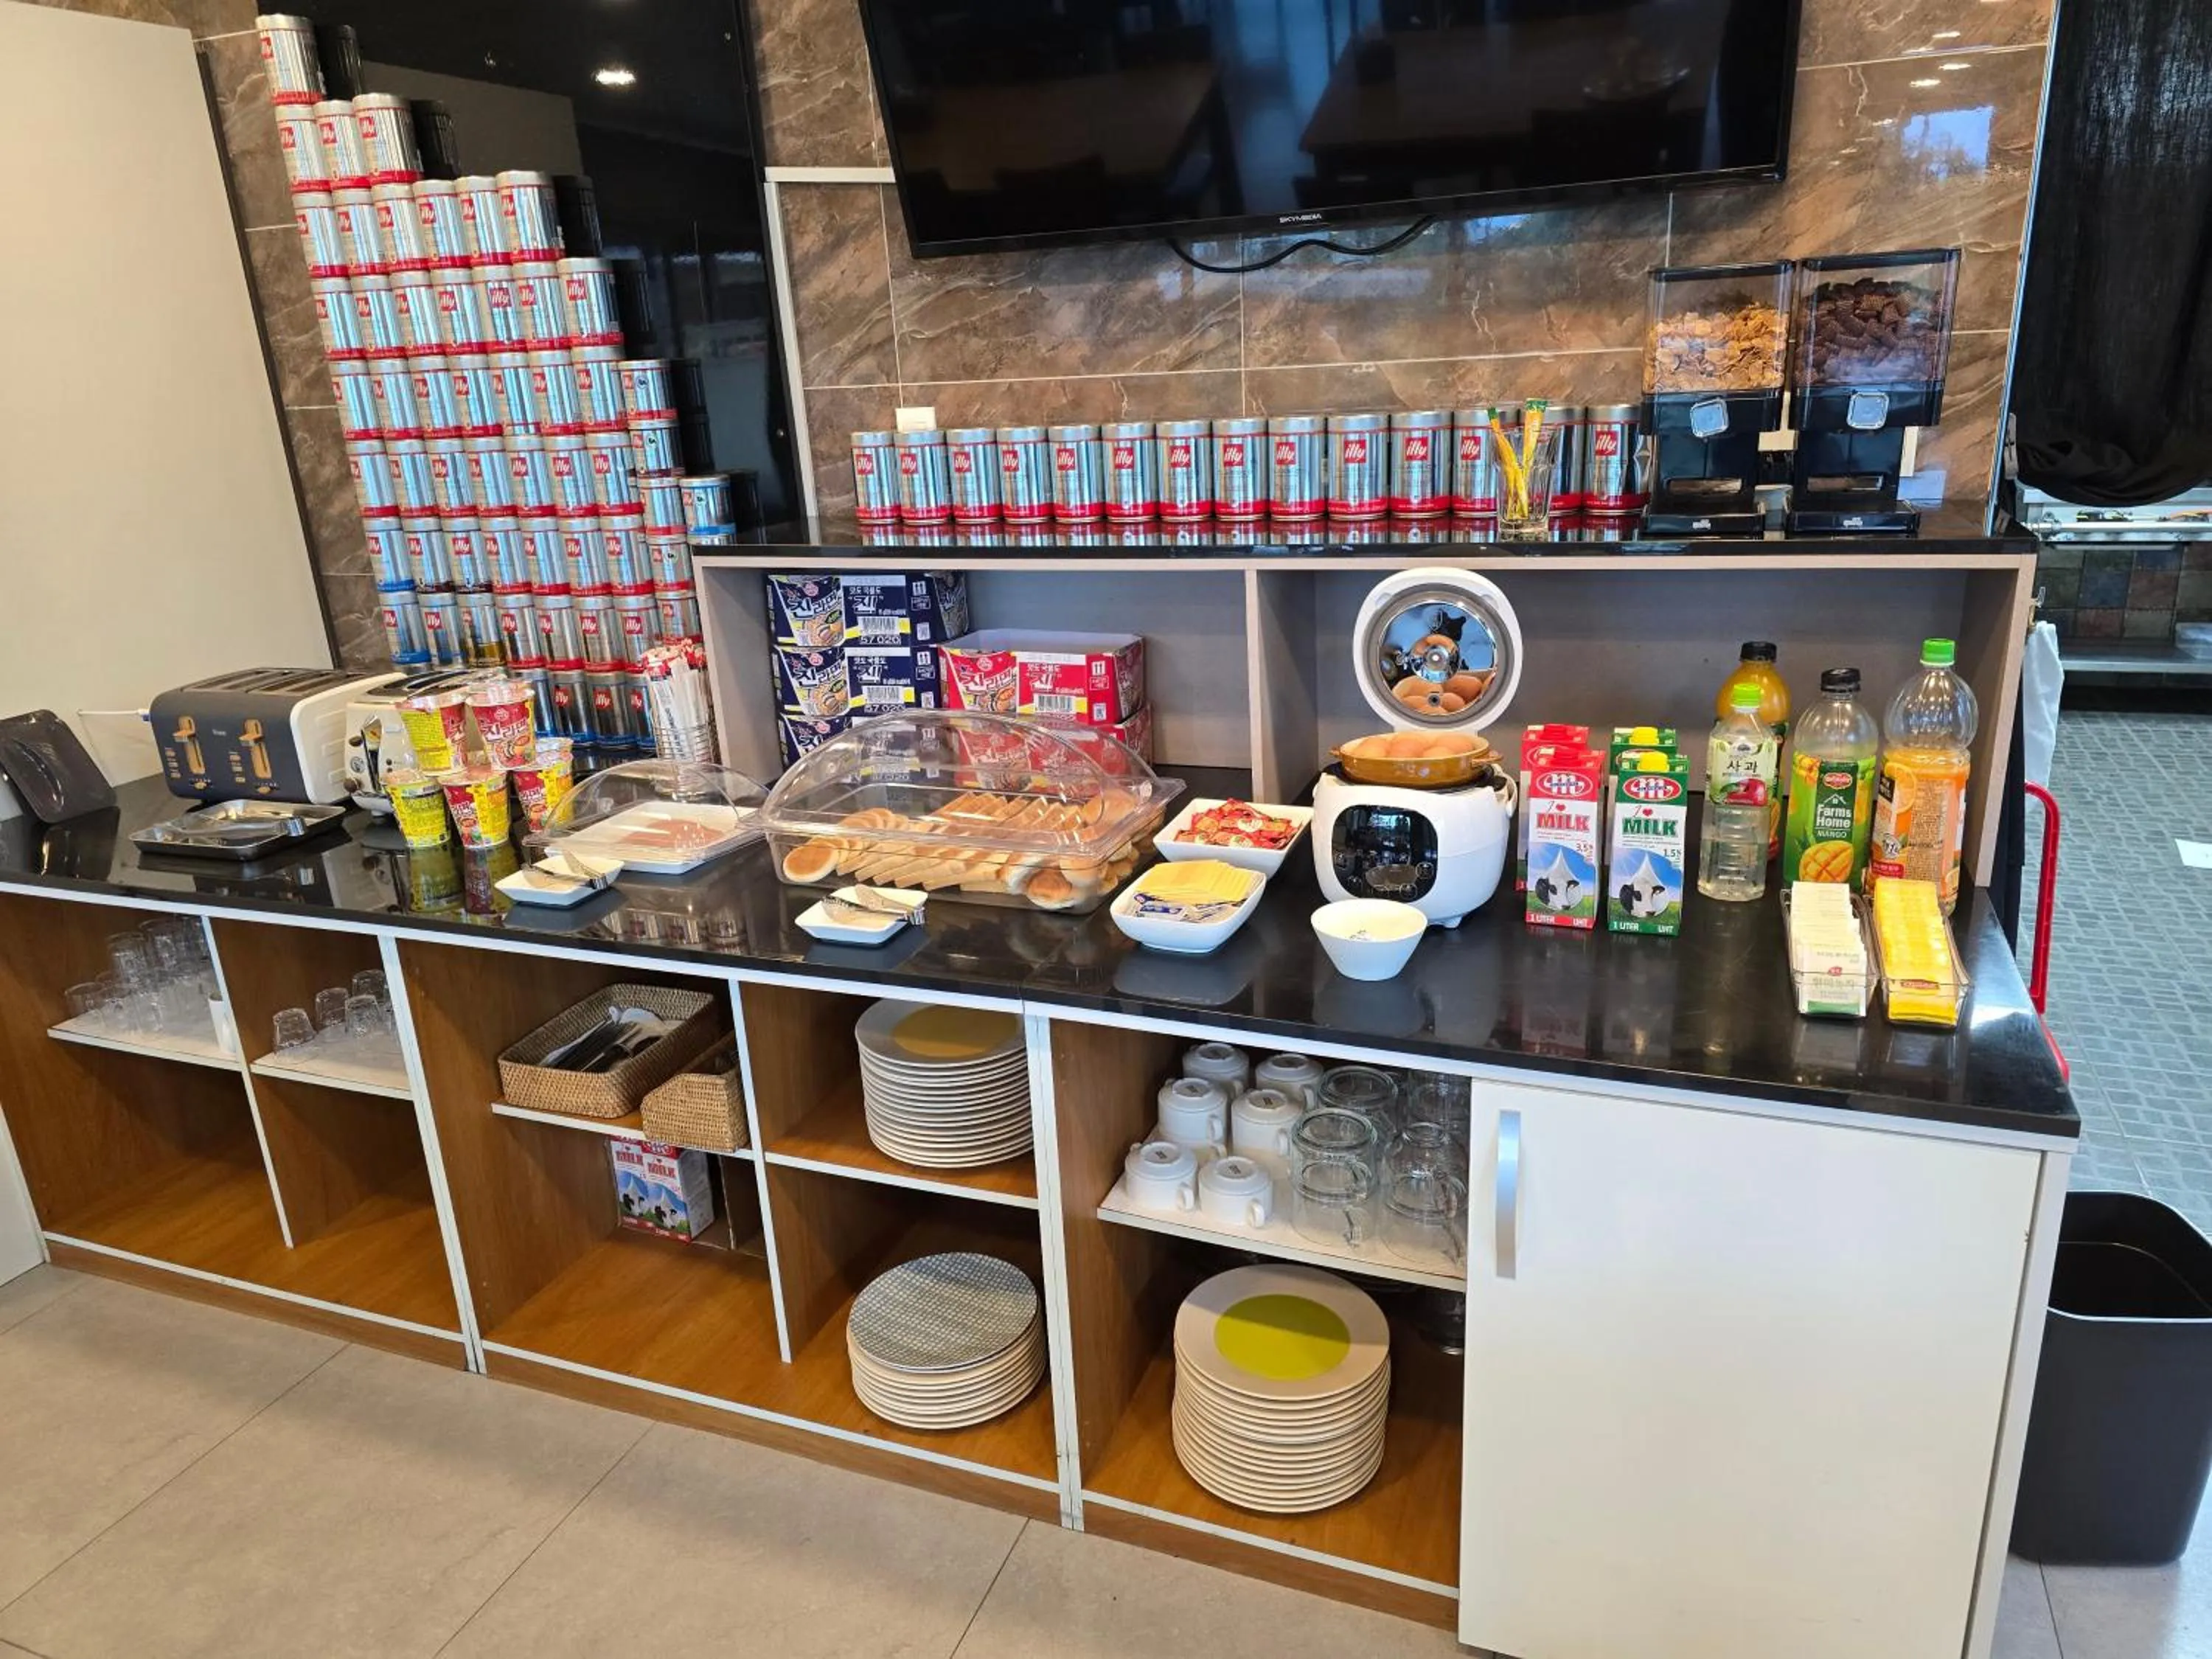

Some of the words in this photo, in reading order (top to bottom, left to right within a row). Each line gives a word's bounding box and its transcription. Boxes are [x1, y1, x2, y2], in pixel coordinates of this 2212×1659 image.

[1346, 443, 1364, 462] illy
[1406, 440, 1427, 459] illy
[1461, 439, 1479, 459] illy
[1596, 434, 1616, 454] illy
[1116, 449, 1133, 467] illy
[1172, 448, 1189, 466] illy
[1225, 447, 1242, 465] illy
[1277, 445, 1294, 464] illy
[1817, 804, 1851, 818] Farms
[1536, 813, 1590, 832] MILK
[1622, 818, 1679, 838] MILK
[1816, 816, 1851, 828] Home
[1817, 830, 1847, 838] MANGO
